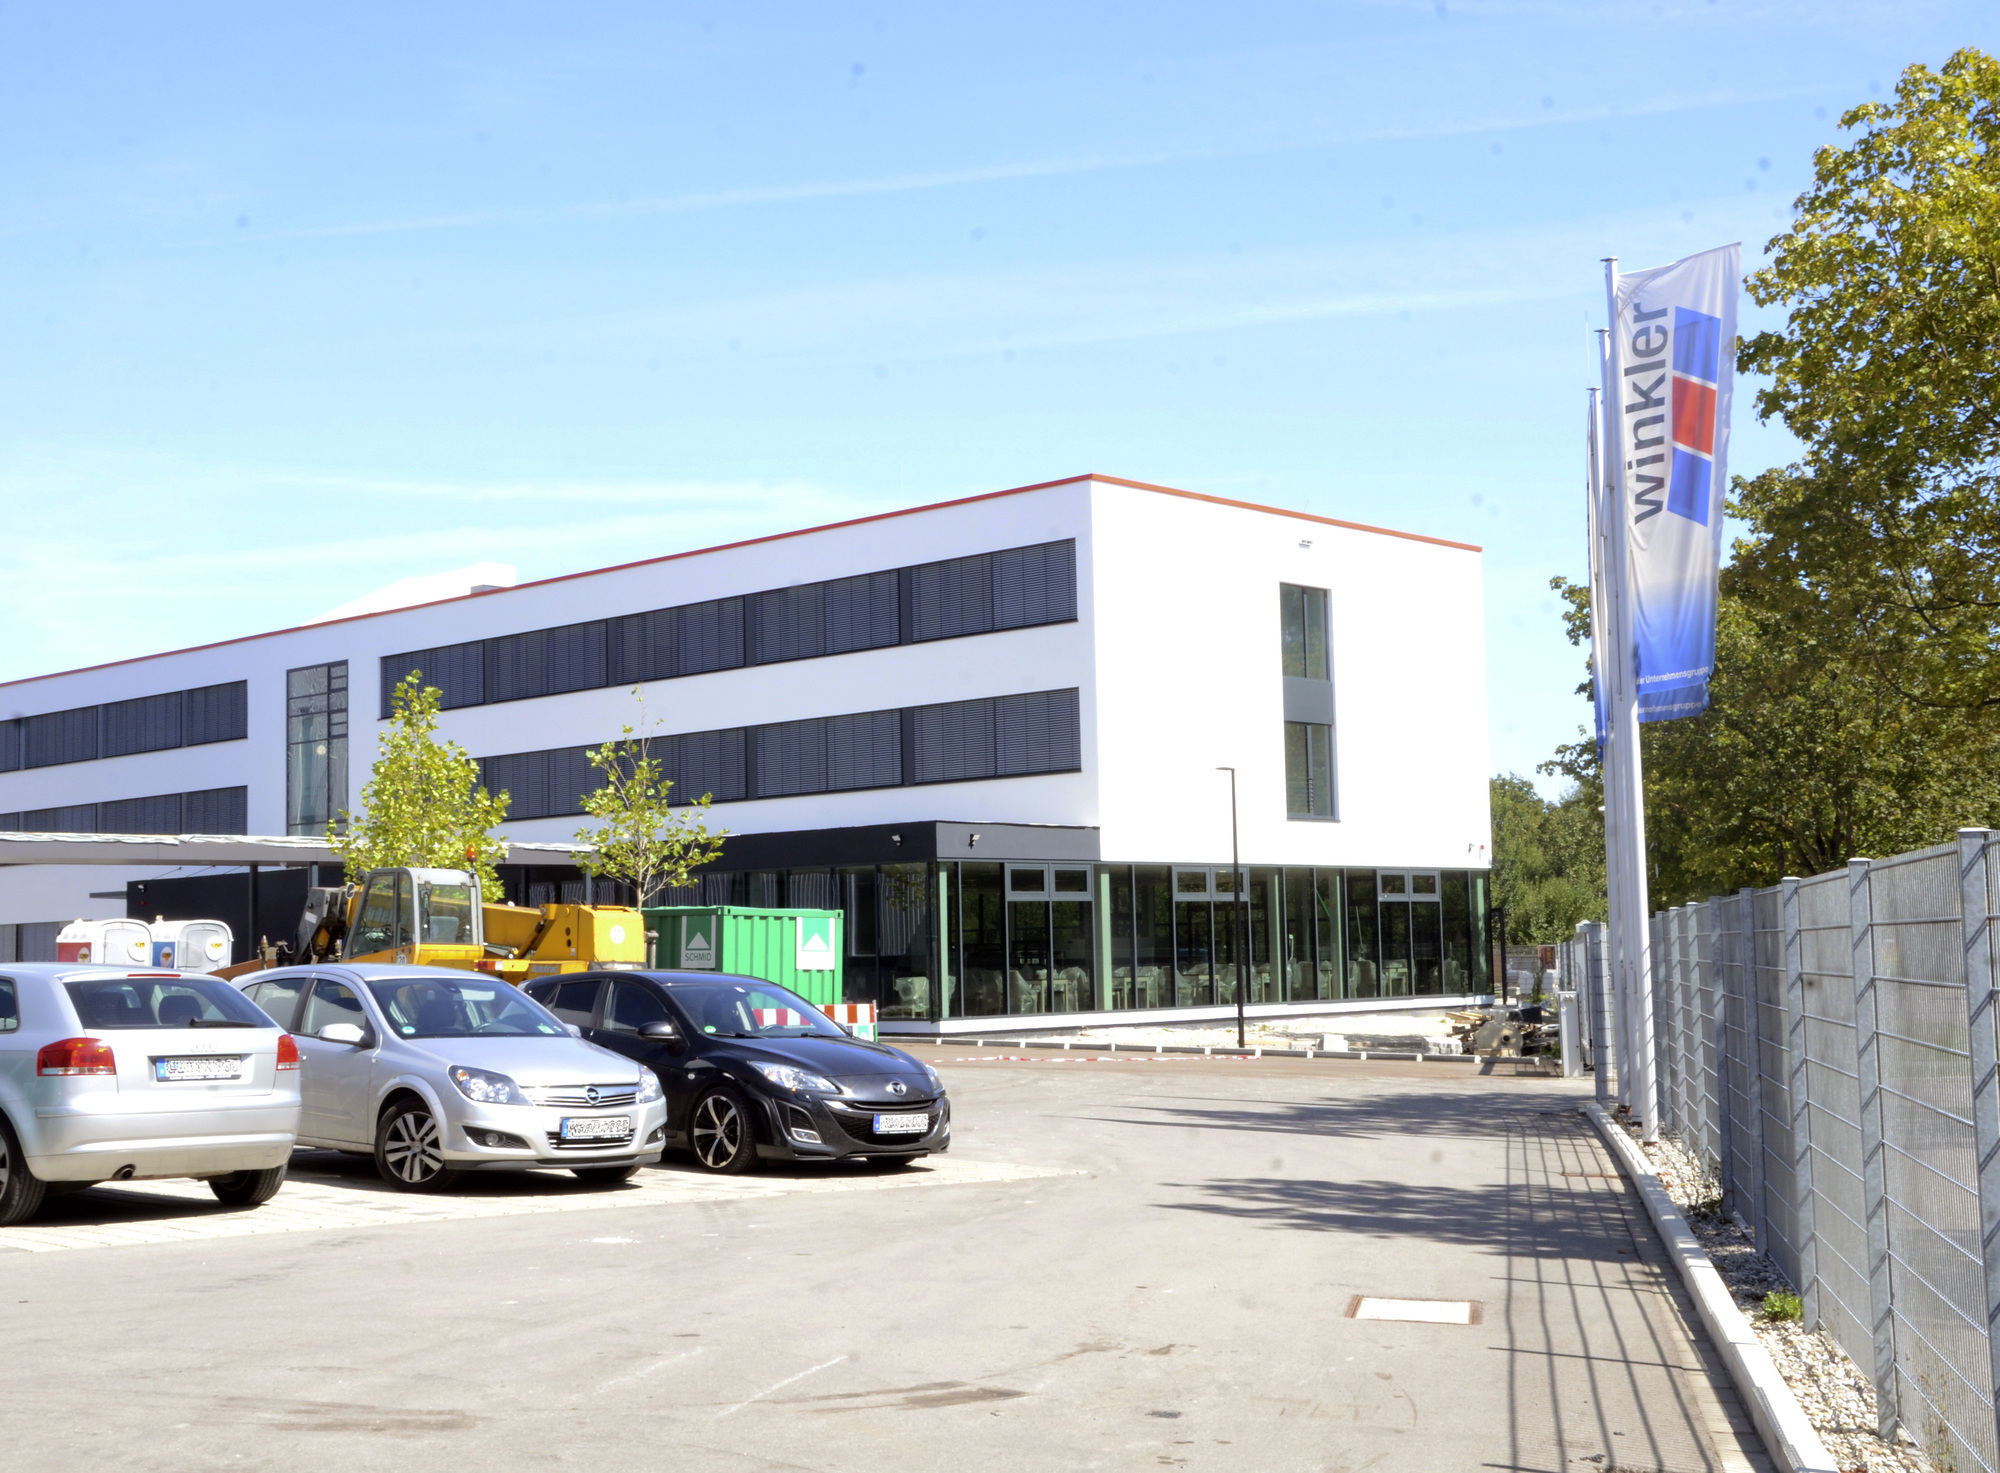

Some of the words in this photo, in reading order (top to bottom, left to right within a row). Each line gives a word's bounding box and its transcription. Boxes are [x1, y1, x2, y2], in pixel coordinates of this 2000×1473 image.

[1624, 302, 1668, 525] winkler
[1645, 666, 1709, 683] Unternehmensgruppe
[685, 952, 711, 961] SCHMID
